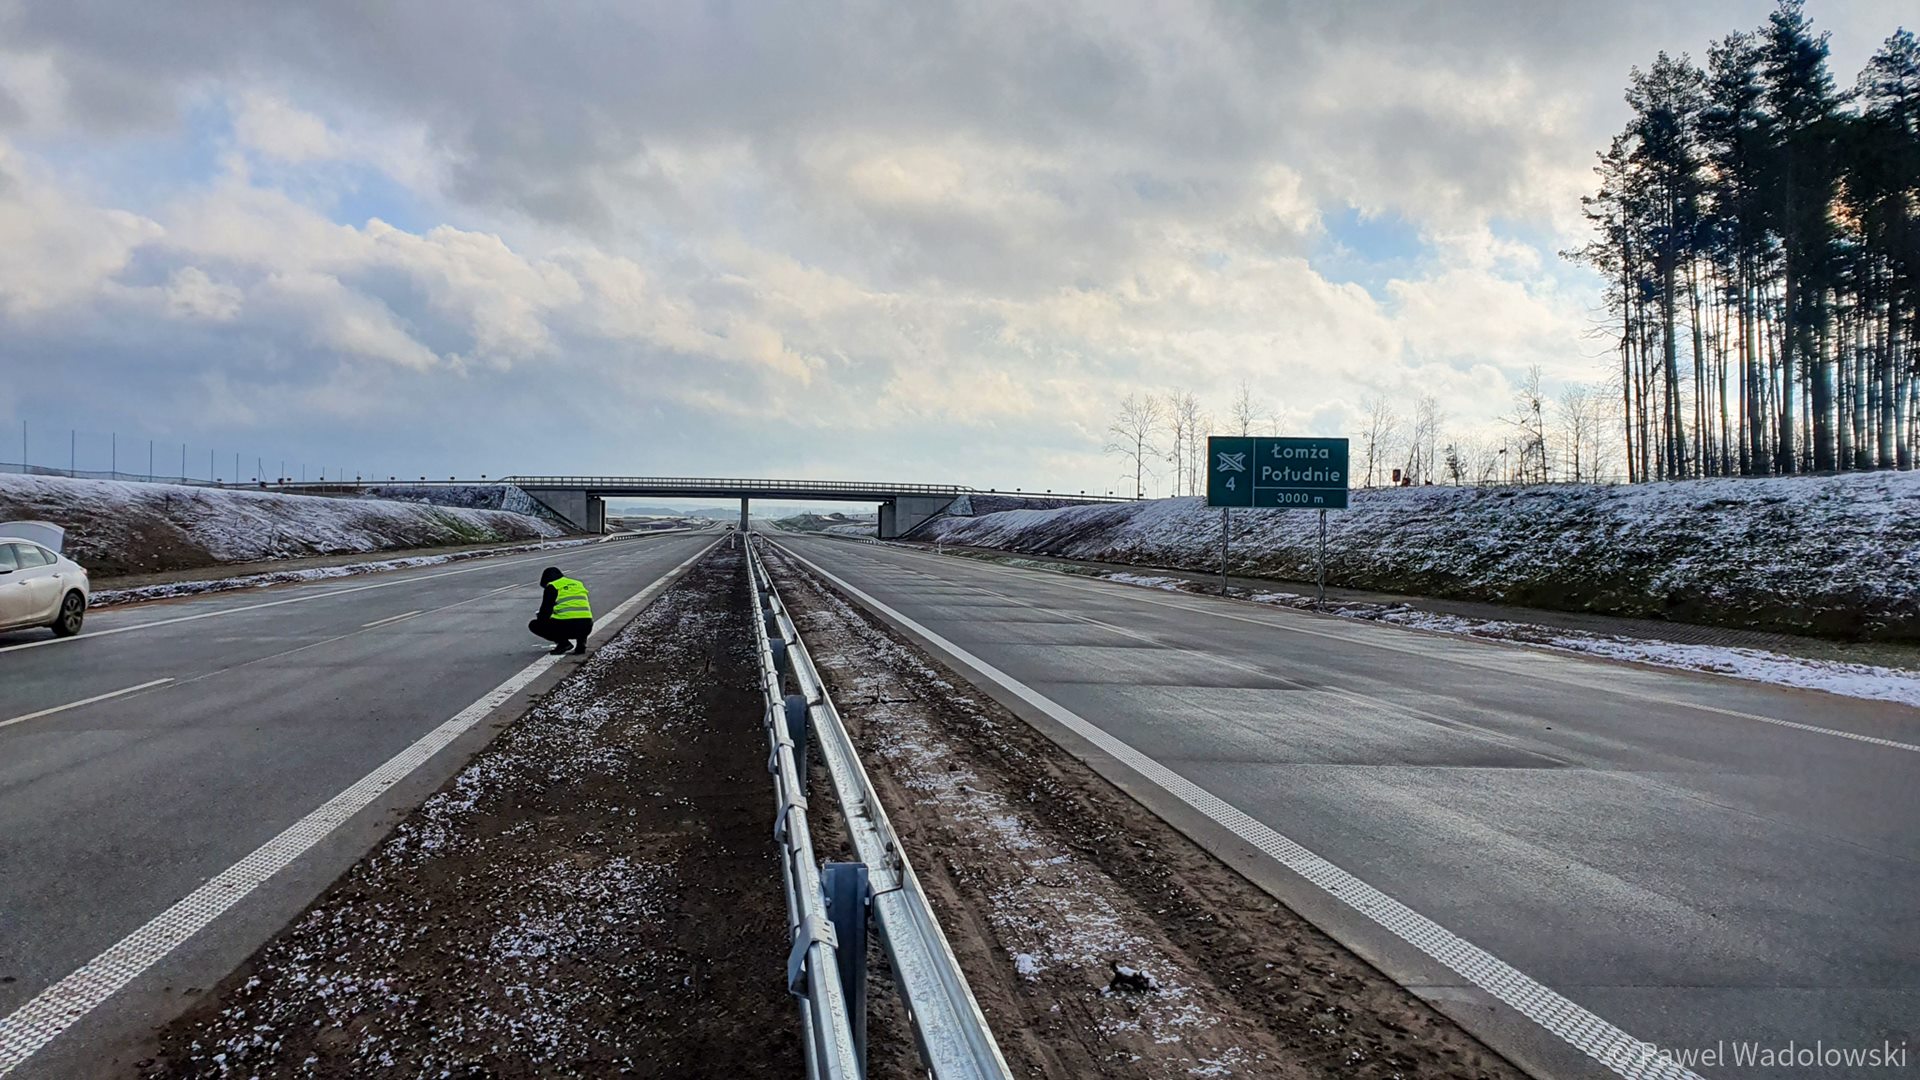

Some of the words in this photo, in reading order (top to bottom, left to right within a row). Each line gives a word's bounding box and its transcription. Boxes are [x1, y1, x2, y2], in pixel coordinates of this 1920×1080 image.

[1271, 443, 1329, 459] Łomża
[1262, 466, 1340, 482] Południe
[1225, 476, 1236, 491] 4
[1277, 493, 1309, 503] 3000
